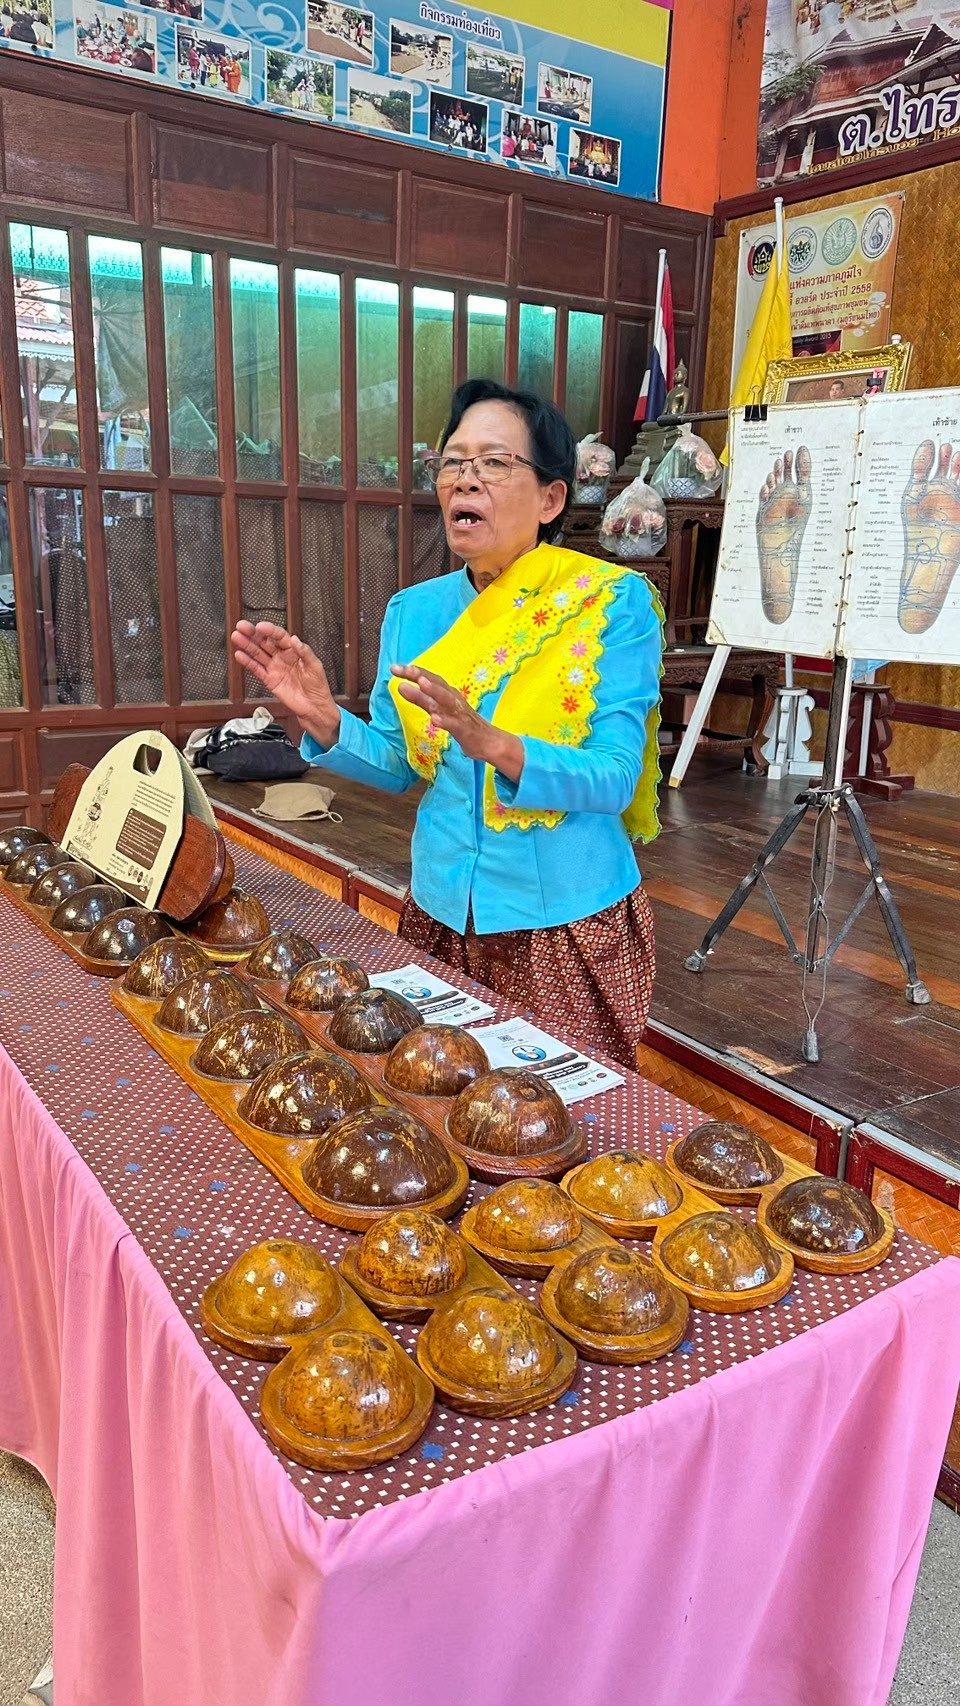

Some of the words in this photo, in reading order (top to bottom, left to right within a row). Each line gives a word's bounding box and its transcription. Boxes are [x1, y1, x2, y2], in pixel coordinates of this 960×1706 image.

[420, 3, 501, 40] กิจกรรมท่องเที่ยว
[820, 284, 848, 300] ประจำปี
[851, 282, 872, 295] 2558
